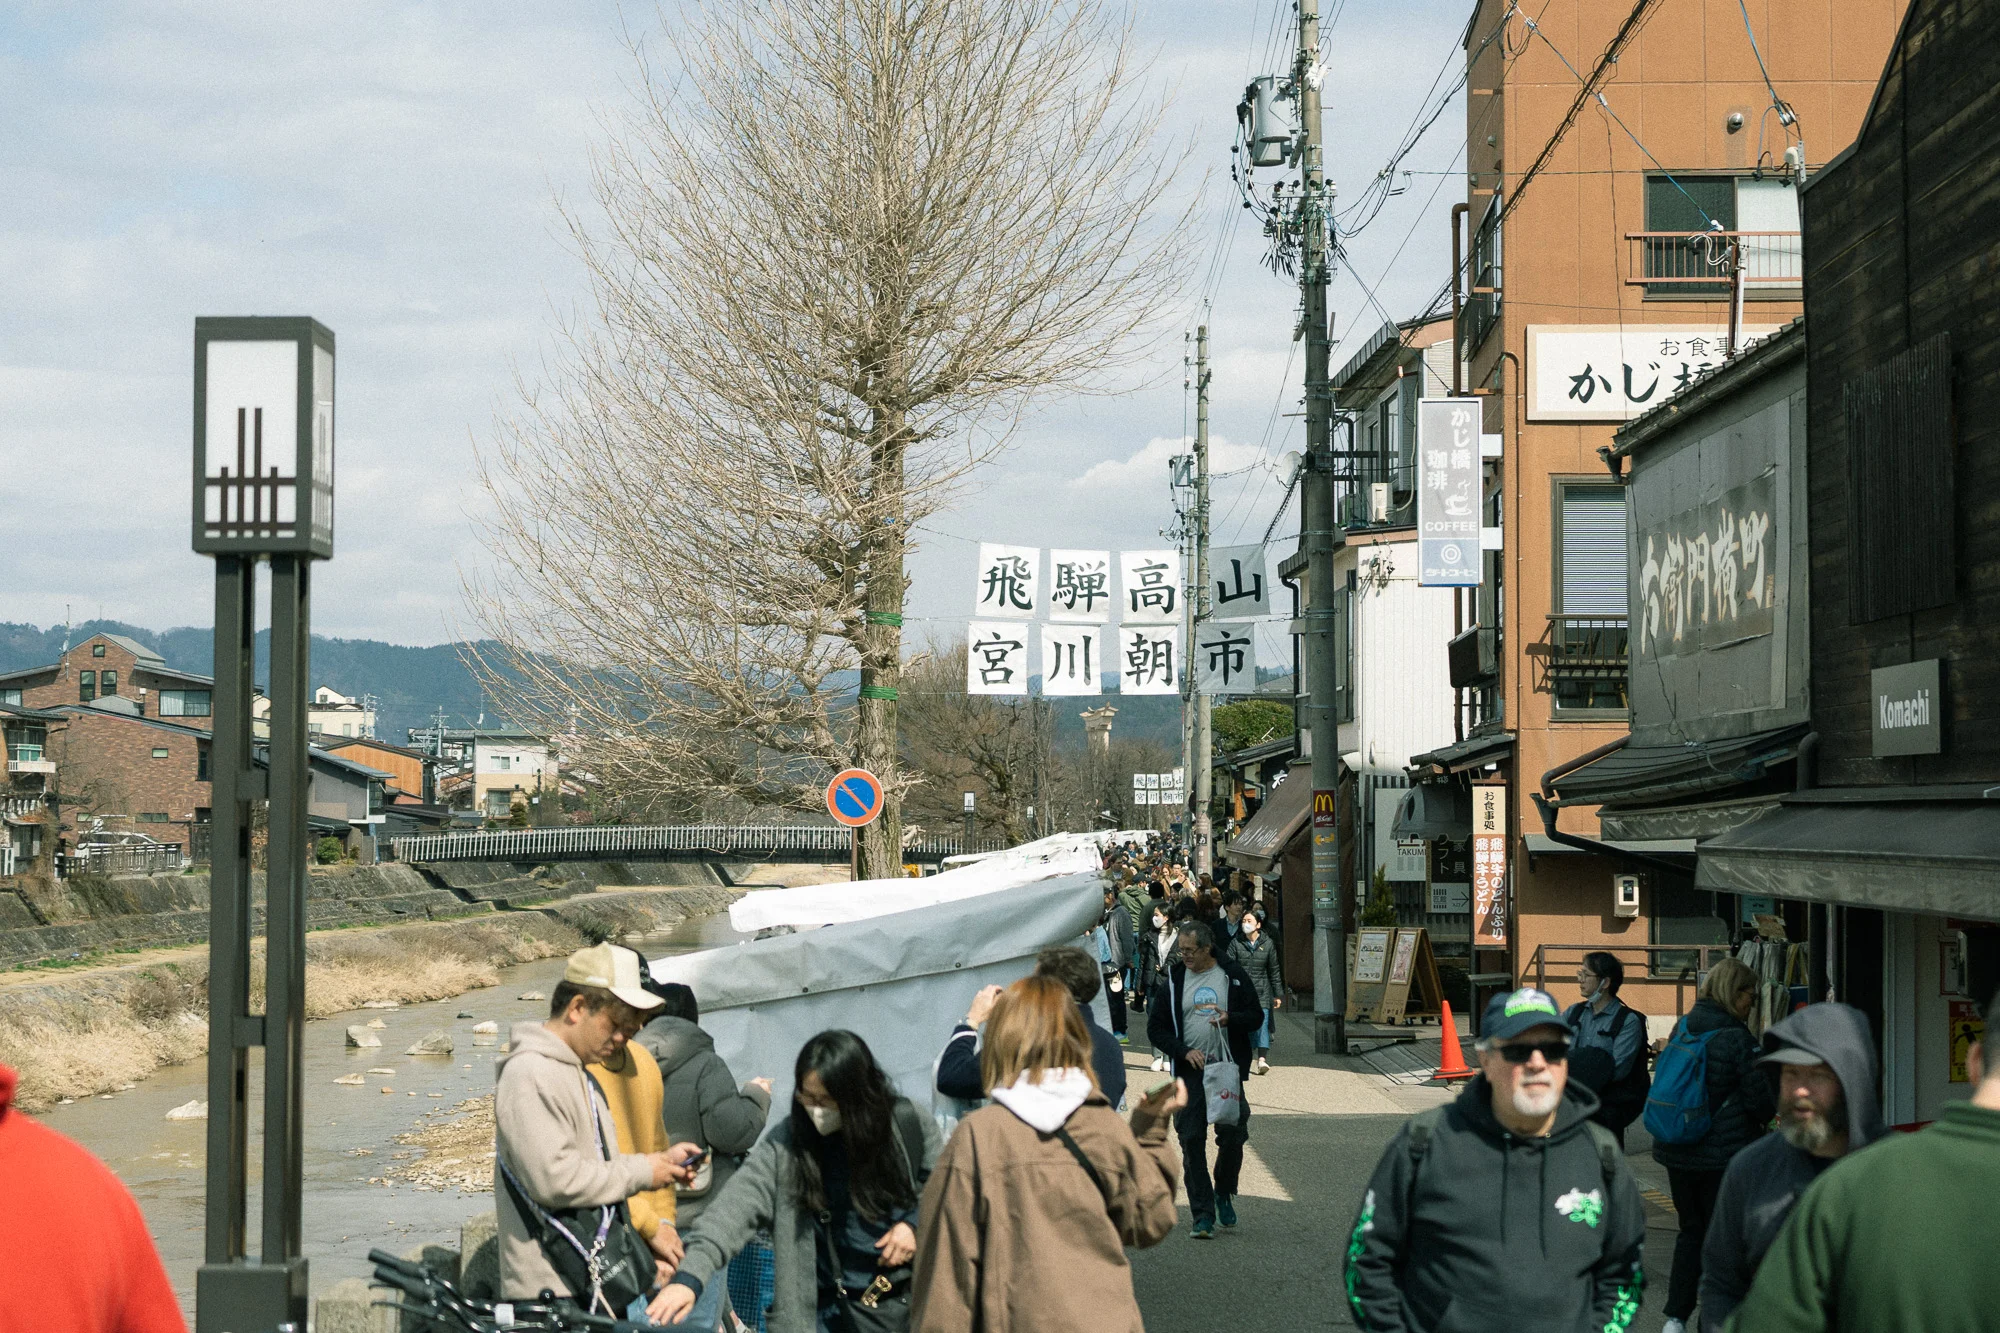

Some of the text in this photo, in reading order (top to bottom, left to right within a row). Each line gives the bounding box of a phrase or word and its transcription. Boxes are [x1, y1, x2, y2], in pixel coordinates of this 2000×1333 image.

[1451, 407, 1471, 470] かじ橋
[1427, 449, 1448, 490] 珈琲
[1425, 521, 1477, 532] COFFEE
[981, 555, 1262, 614] 飛騨高山
[972, 630, 1251, 687] 宮川朝市
[1880, 689, 1929, 729] Komachi
[1484, 791, 1495, 831] お食事処
